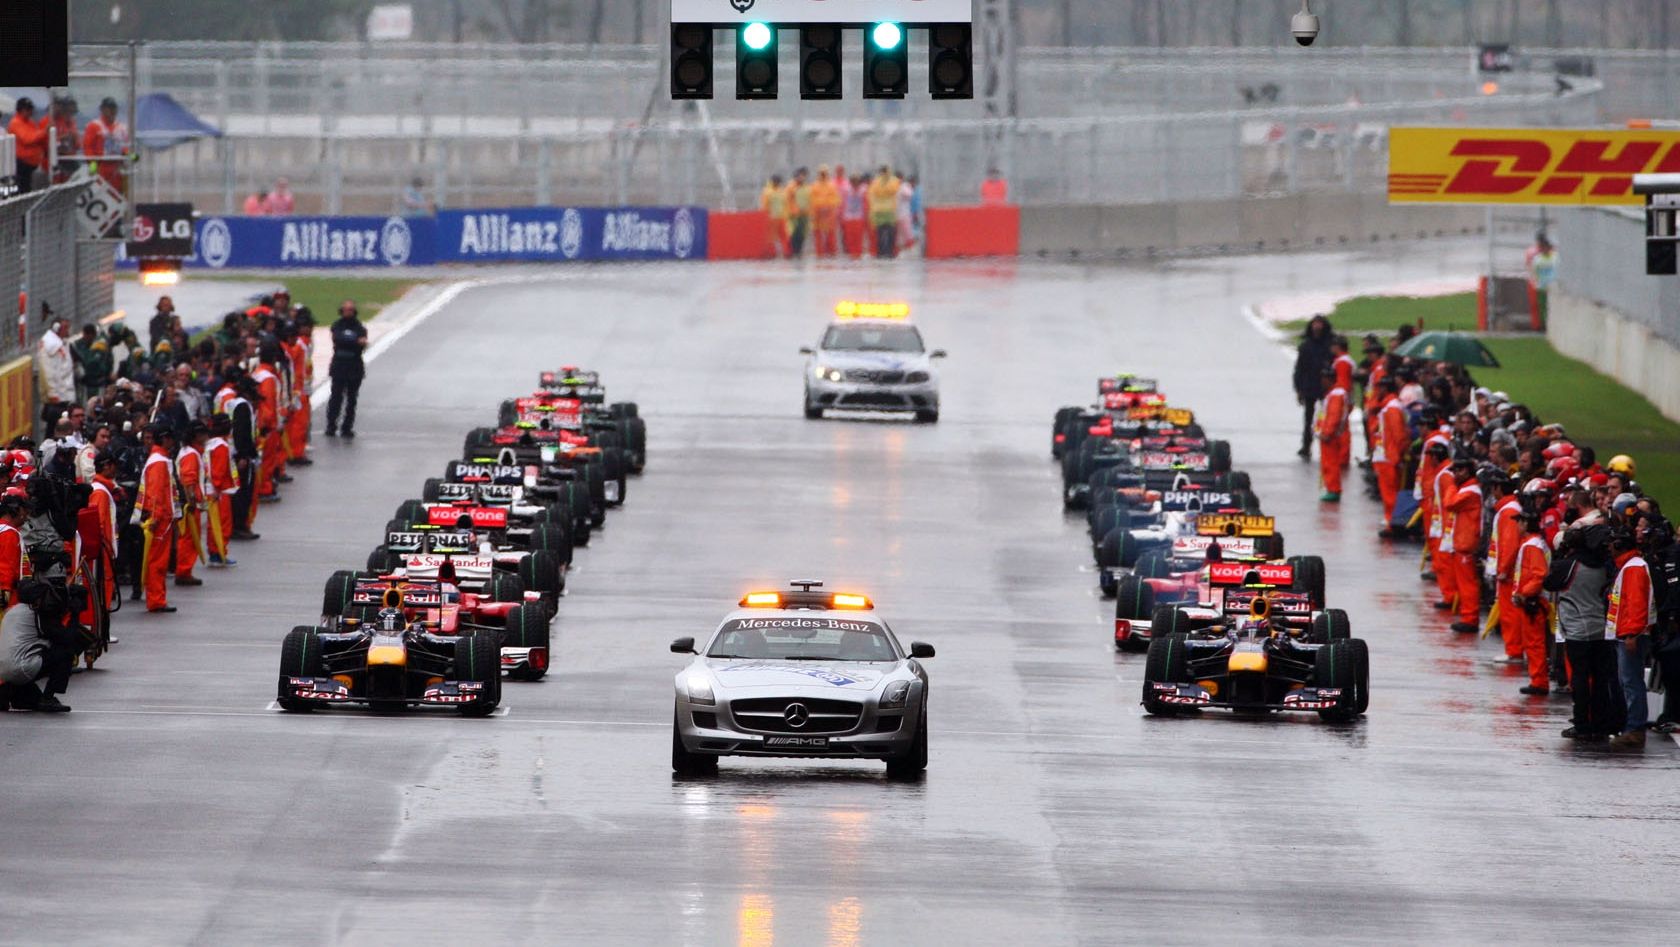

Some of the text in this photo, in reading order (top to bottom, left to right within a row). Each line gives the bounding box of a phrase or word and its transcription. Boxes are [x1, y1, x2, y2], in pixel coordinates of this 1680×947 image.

[159, 219, 190, 238] LG
[460, 214, 558, 253] Allianz
[281, 221, 378, 261] Allianz
[456, 464, 522, 477] PHIIPS
[1164, 491, 1231, 504] PHIIPS
[431, 508, 505, 520] vodfone
[424, 556, 492, 568] Satander
[1212, 565, 1290, 578] vodfone
[737, 618, 870, 633] Mercedes-Benz
[786, 737, 826, 746] AMG
